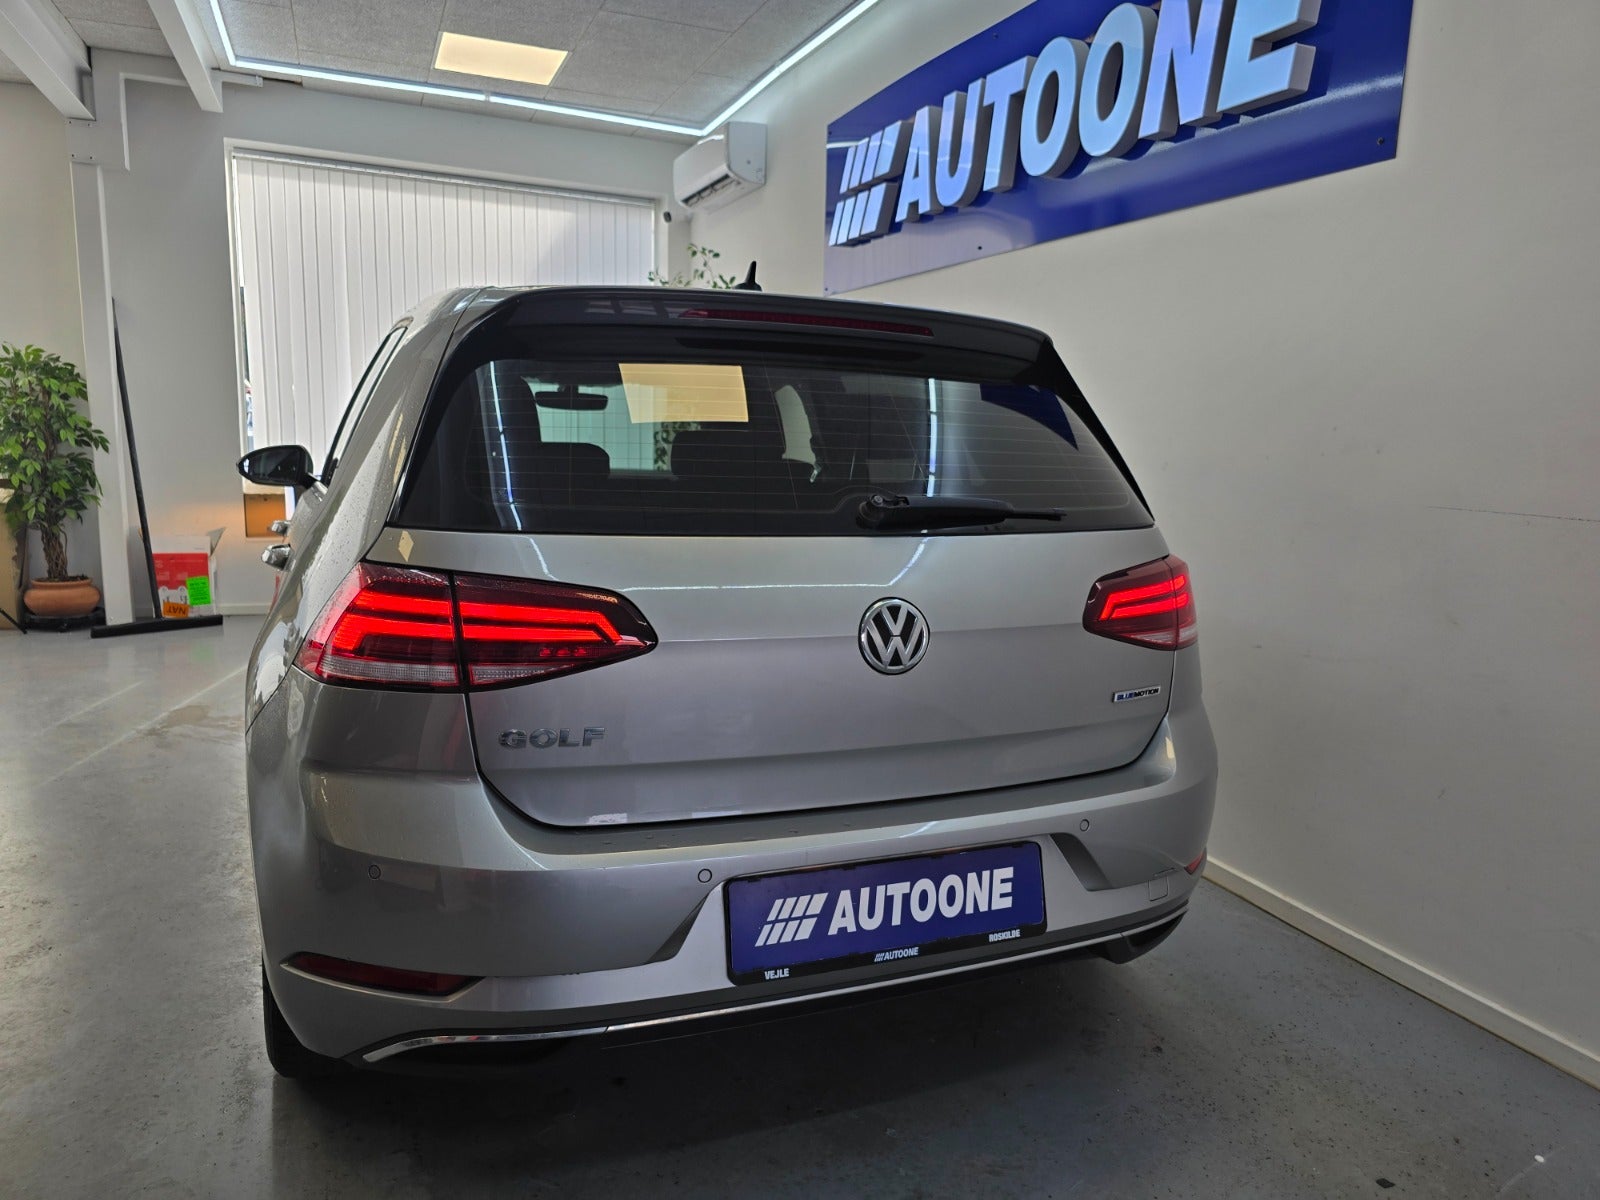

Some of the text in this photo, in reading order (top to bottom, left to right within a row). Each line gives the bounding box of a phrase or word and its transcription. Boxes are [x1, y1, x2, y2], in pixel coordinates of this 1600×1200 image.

[895, 0, 1318, 223] AUTOONE
[1116, 687, 1160, 702] BLUEMOTION
[498, 727, 605, 749] GOLF
[827, 866, 1014, 935] AUTOONE
[988, 929, 1021, 943] ROSKILDE
[884, 947, 919, 961] AUTOONE
[764, 968, 790, 981] VEJLE
